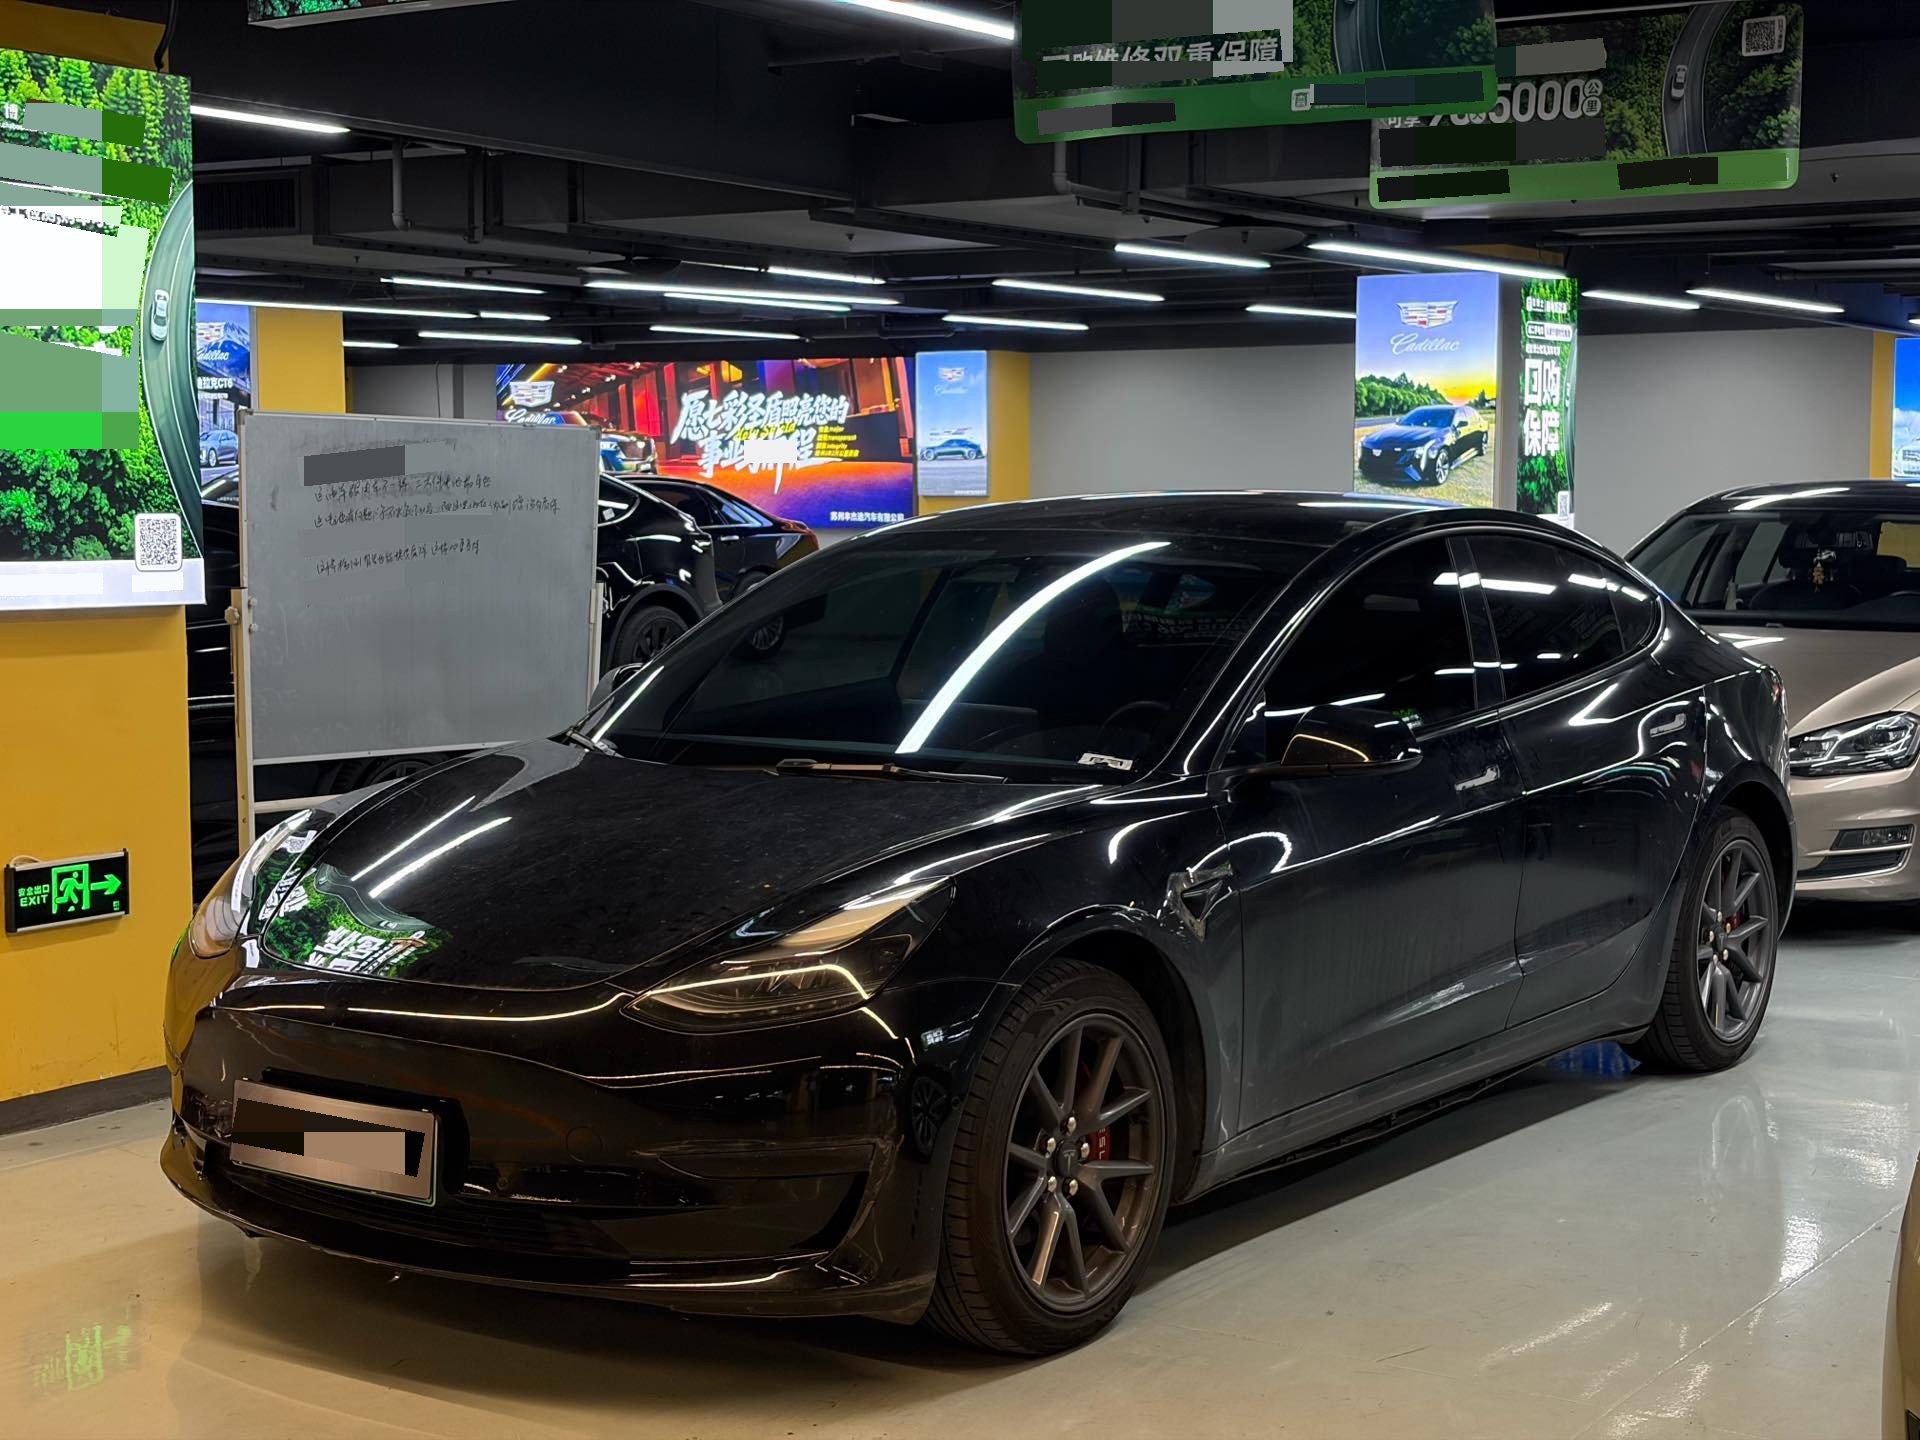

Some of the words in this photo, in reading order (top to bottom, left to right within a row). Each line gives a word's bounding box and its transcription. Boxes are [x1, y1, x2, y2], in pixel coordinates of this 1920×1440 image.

[1391, 333, 1460, 356] Cadillac
[1524, 358, 1561, 406] 回购
[669, 389, 850, 444] 愿七彩圣盾照亮您的
[1523, 408, 1561, 457] 保障
[18, 884, 50, 898] 安全出口
[20, 894, 48, 907] EXIT
